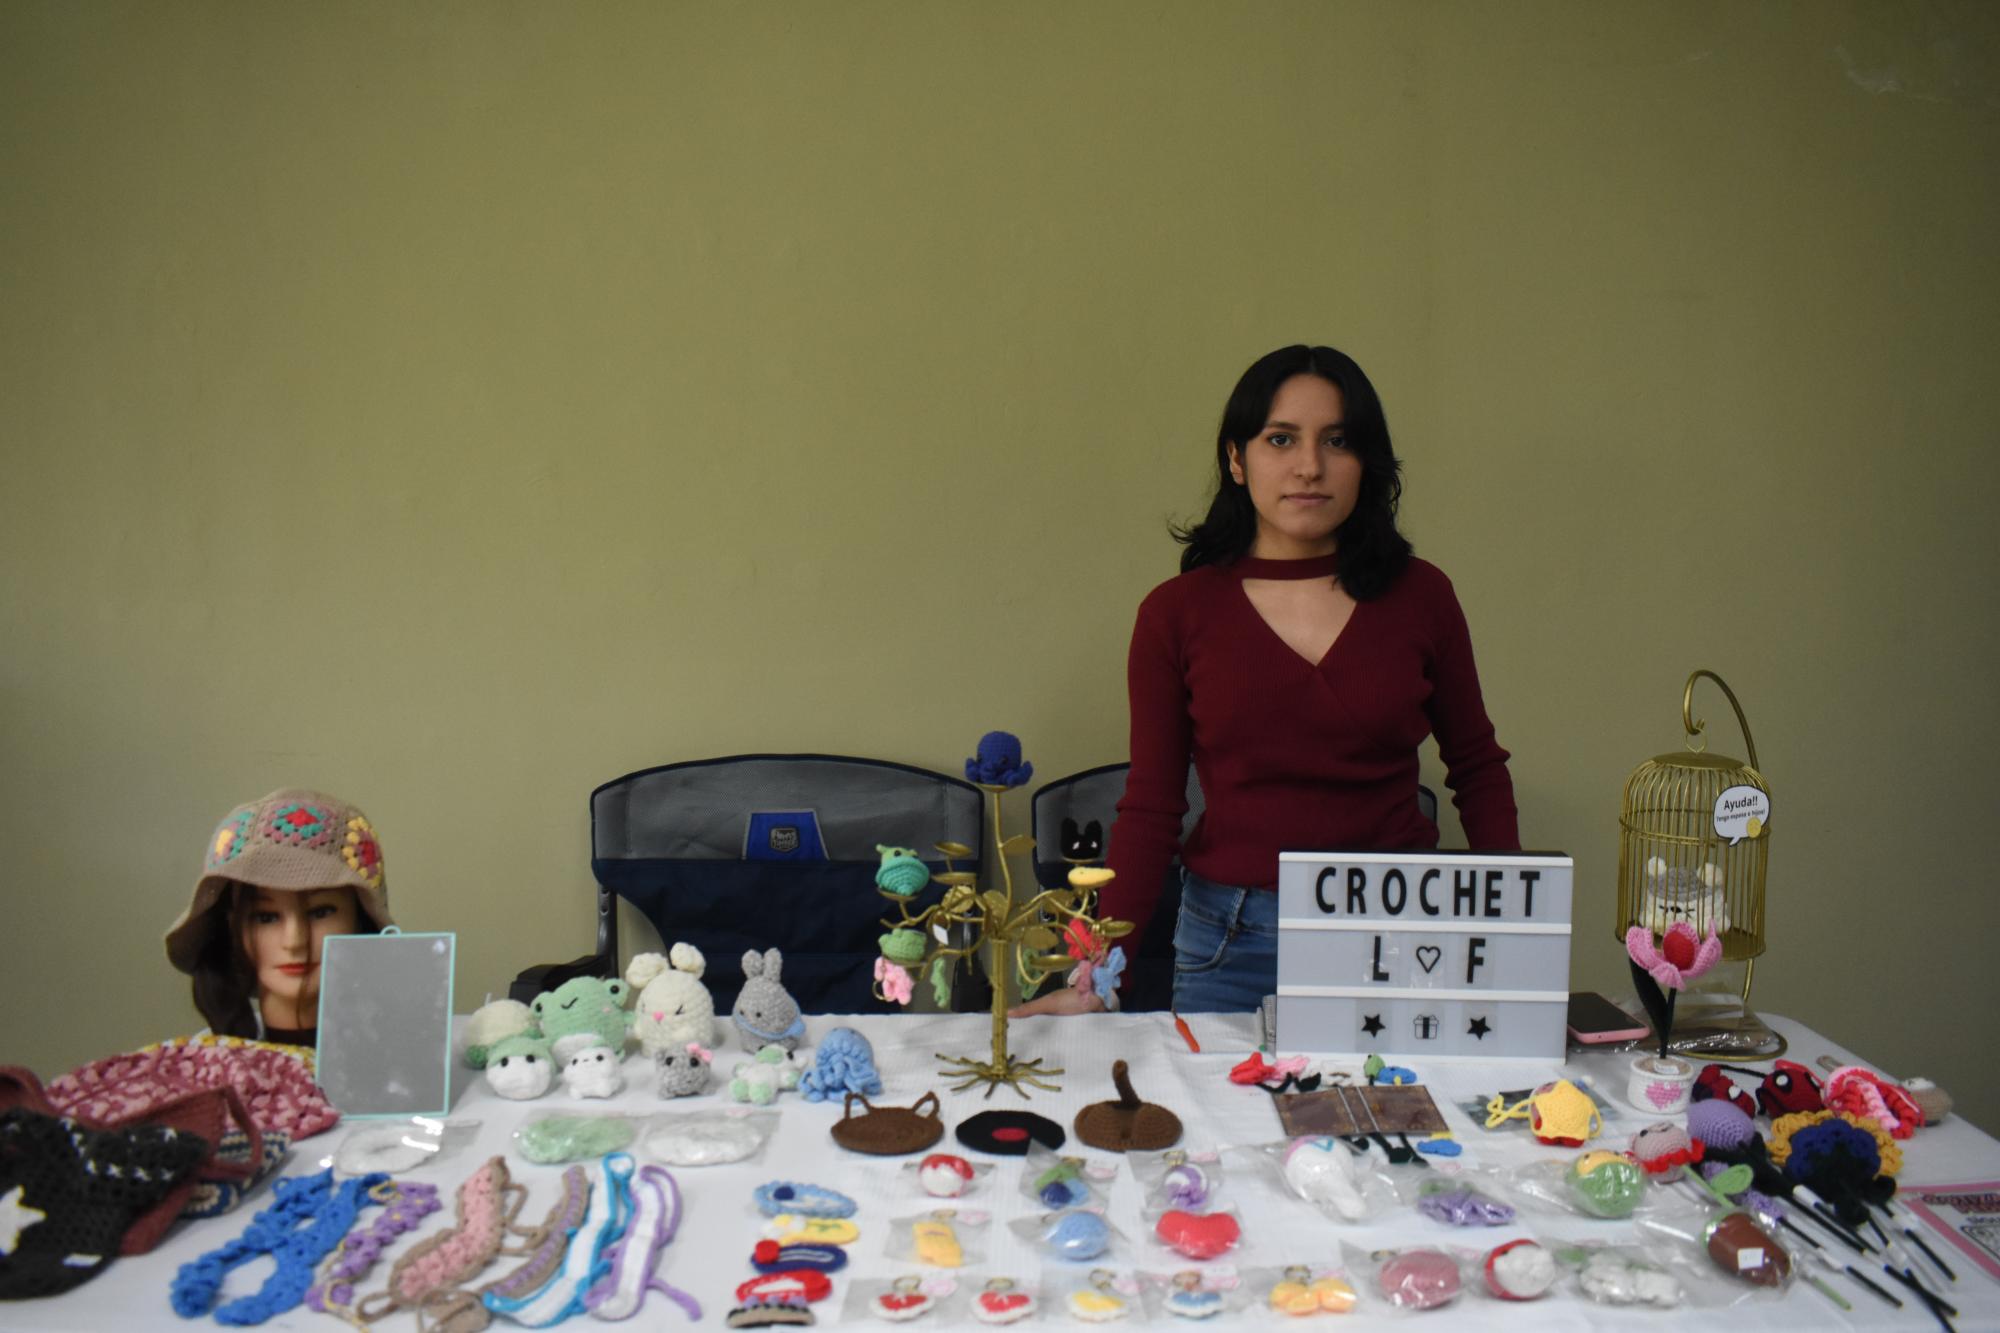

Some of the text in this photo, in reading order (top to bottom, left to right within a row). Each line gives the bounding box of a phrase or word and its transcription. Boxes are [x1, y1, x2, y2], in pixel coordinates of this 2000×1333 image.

[1724, 795, 1758, 812] Ayuda!!
[1315, 866, 1541, 918] CROCHET
[1372, 935, 1486, 984] L F
